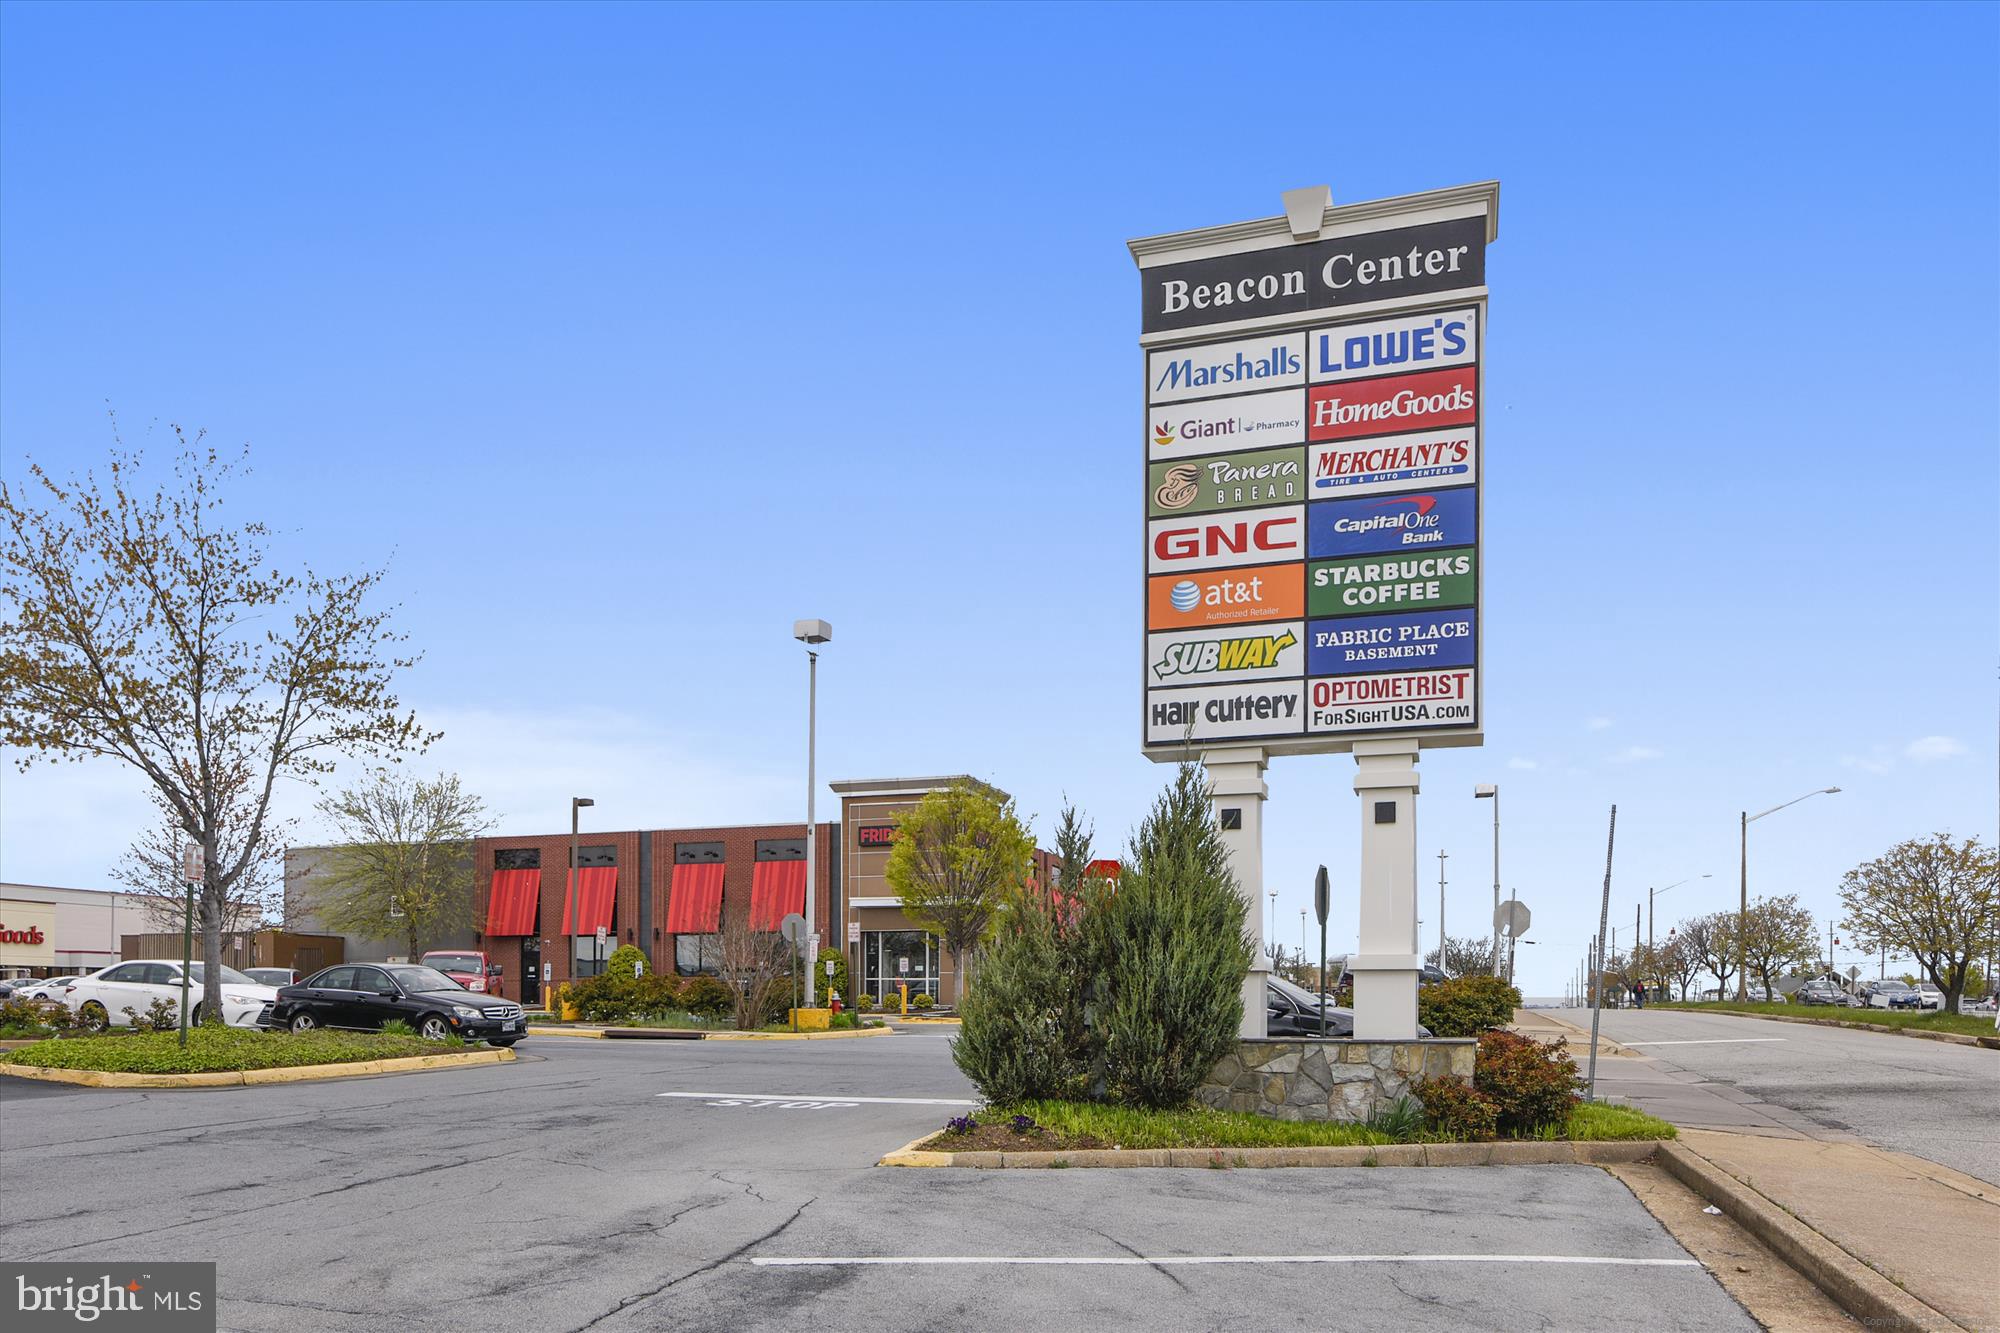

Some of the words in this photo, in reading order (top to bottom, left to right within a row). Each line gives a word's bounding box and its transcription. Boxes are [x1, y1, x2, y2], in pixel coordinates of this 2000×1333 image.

[1161, 269, 1306, 314] Beacon
[1322, 246, 1468, 289] Center
[1320, 319, 1466, 373] LOWE'S
[1156, 346, 1300, 391] Marshalls
[1313, 384, 1473, 427] HomeGoods
[1180, 418, 1235, 439] Giant
[1256, 420, 1300, 431] Pharmacy
[1208, 461, 1298, 484] Panera
[1316, 440, 1469, 477] MERCHANT'S
[1330, 478, 1350, 486] TIRE
[1373, 473, 1398, 481] AUTO
[1411, 467, 1454, 478] CENTERS
[1217, 482, 1294, 504] BREAD
[1154, 517, 1297, 561] GNC
[1402, 529, 1443, 545] Bank
[1314, 556, 1470, 587] STARBUCKS
[1205, 576, 1262, 606] at&t
[1343, 581, 1440, 606] COFFEE
[1206, 609, 1248, 620] Authorized
[1250, 607, 1279, 616] Retailer
[1315, 628, 1392, 648] FABRIC
[1398, 622, 1469, 642] PLACE
[1153, 628, 1298, 680] SUBWAY
[1345, 643, 1438, 662] BASEMENT
[1313, 673, 1469, 708] OPTOMETRIST
[706, 1100, 860, 1110] STOP
